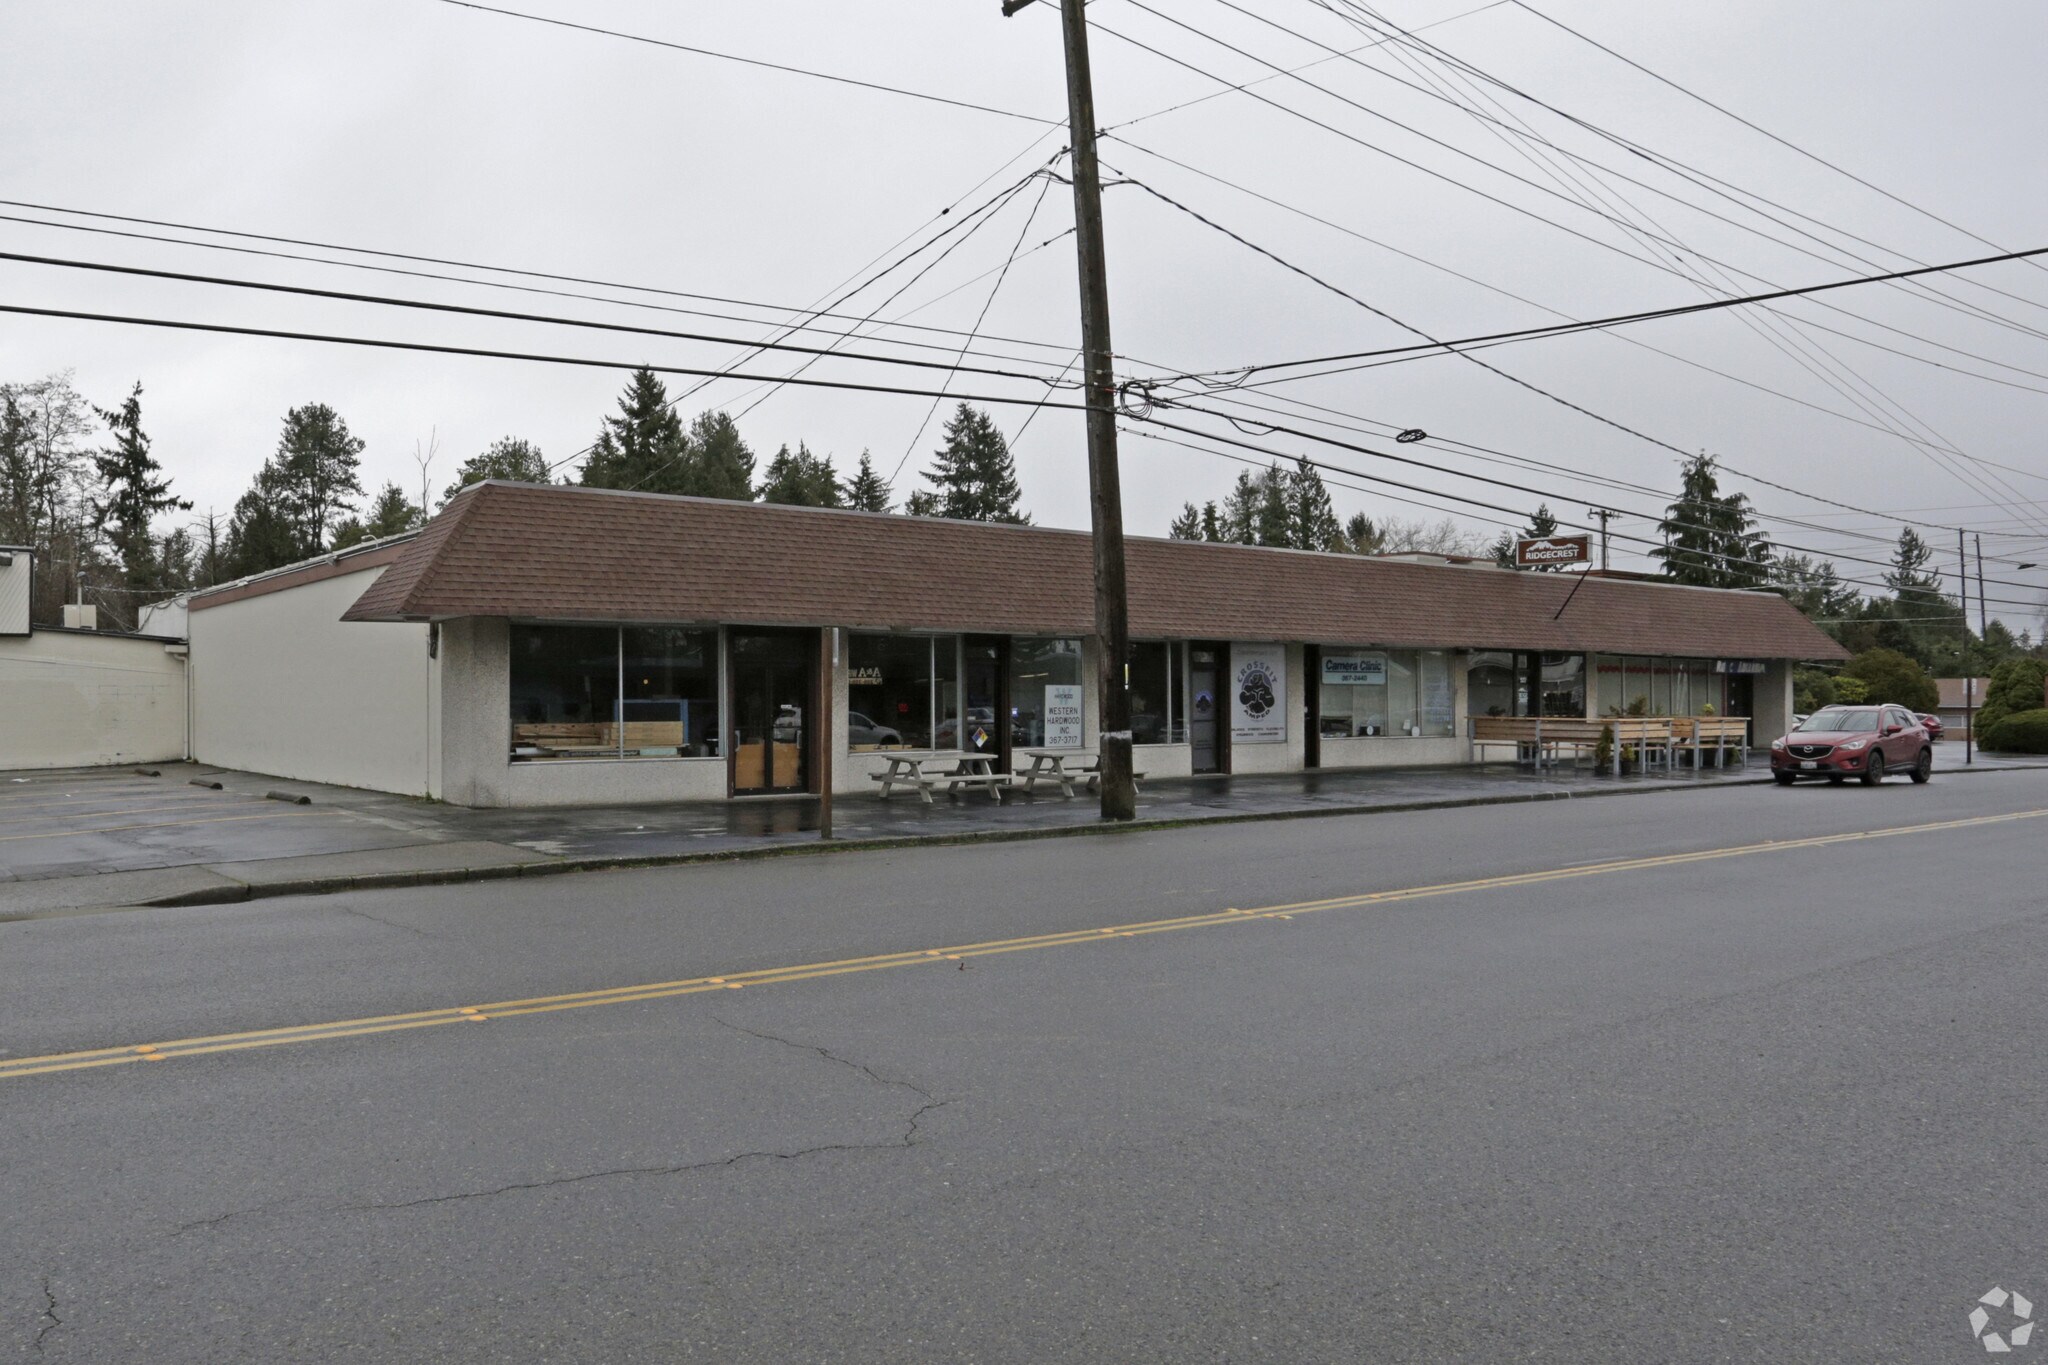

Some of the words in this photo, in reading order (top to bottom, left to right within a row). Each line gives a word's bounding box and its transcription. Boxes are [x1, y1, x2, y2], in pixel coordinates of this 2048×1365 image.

[1525, 549, 1579, 560] RIDGECREST
[1325, 659, 1358, 671] Camera
[1360, 660, 1382, 671] Clinic
[1237, 661, 1277, 683] CROSSFIT
[1049, 707, 1078, 715] WESTERN
[1244, 709, 1270, 719] AMPED
[1047, 717, 1080, 725] HARDWOOD
[1049, 736, 1077, 744] 367-3717
